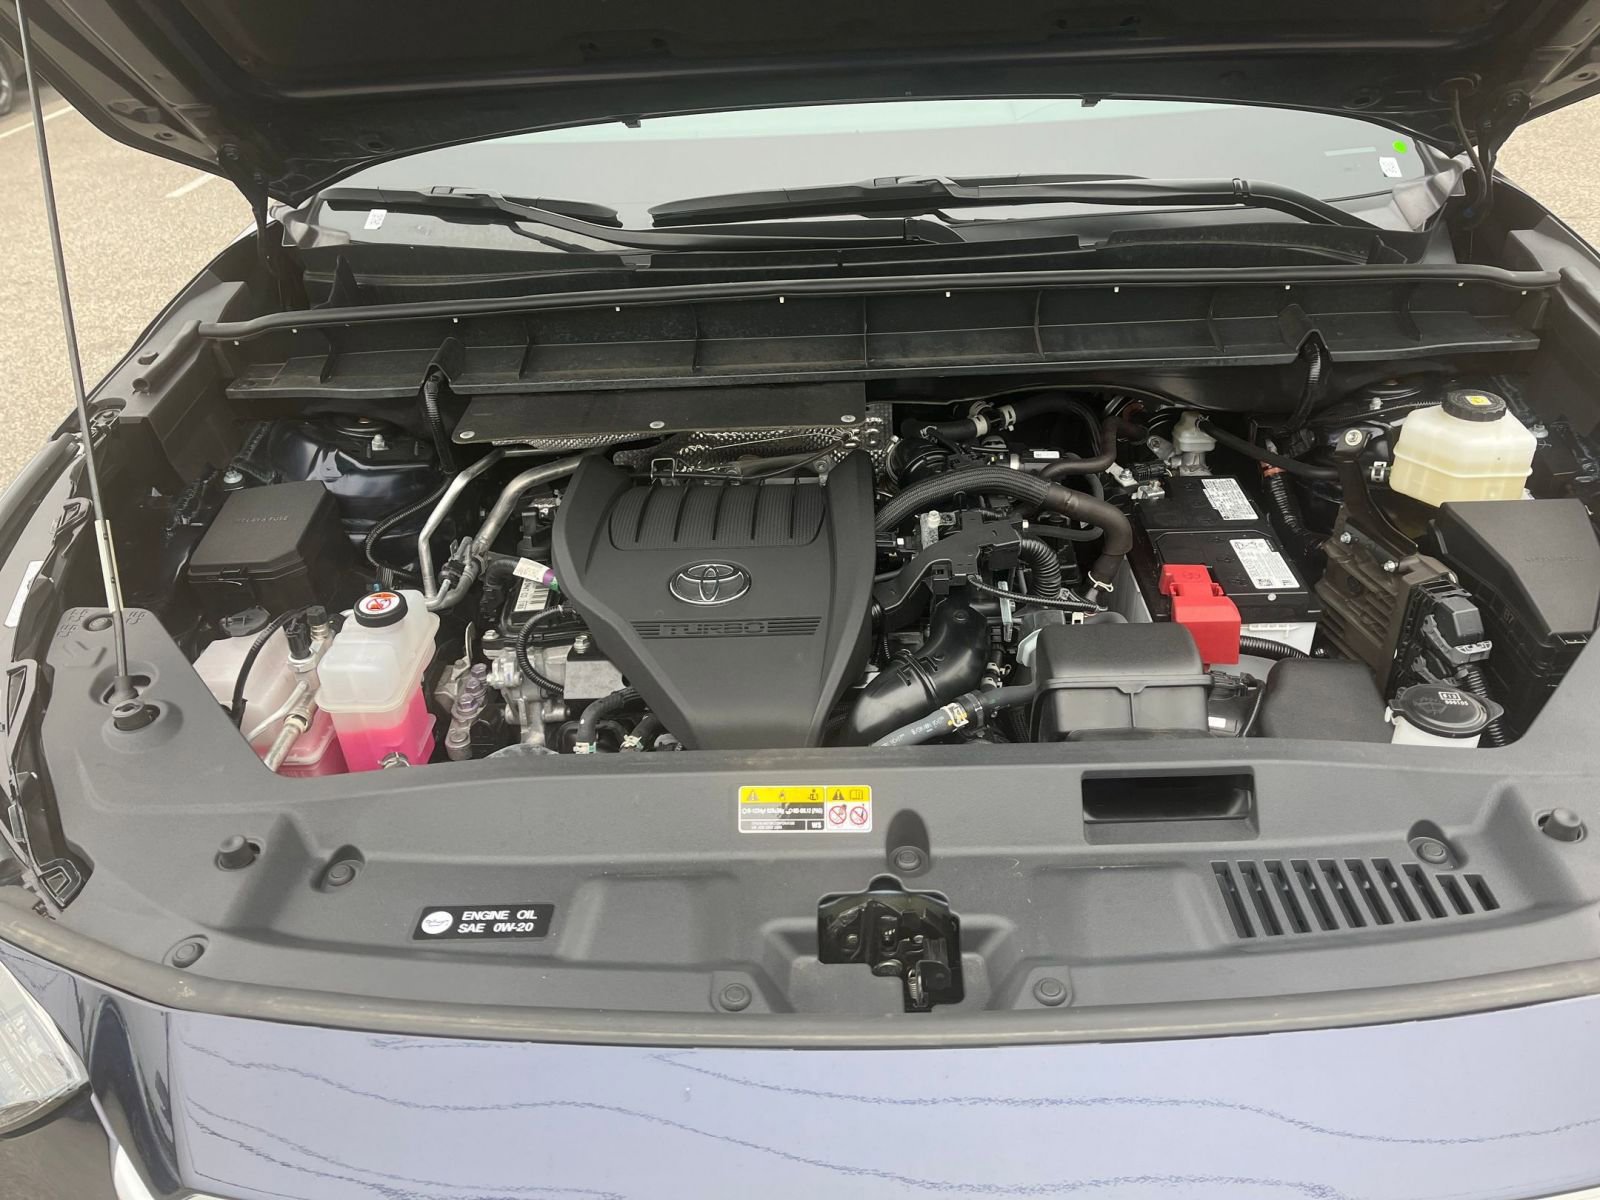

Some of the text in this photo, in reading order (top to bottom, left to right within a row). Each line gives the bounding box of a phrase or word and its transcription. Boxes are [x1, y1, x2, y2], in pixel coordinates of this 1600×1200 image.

[662, 621, 765, 636] TURBO
[461, 909, 538, 921] ENGINE OIL
[457, 922, 535, 934] SAE 0W-20
